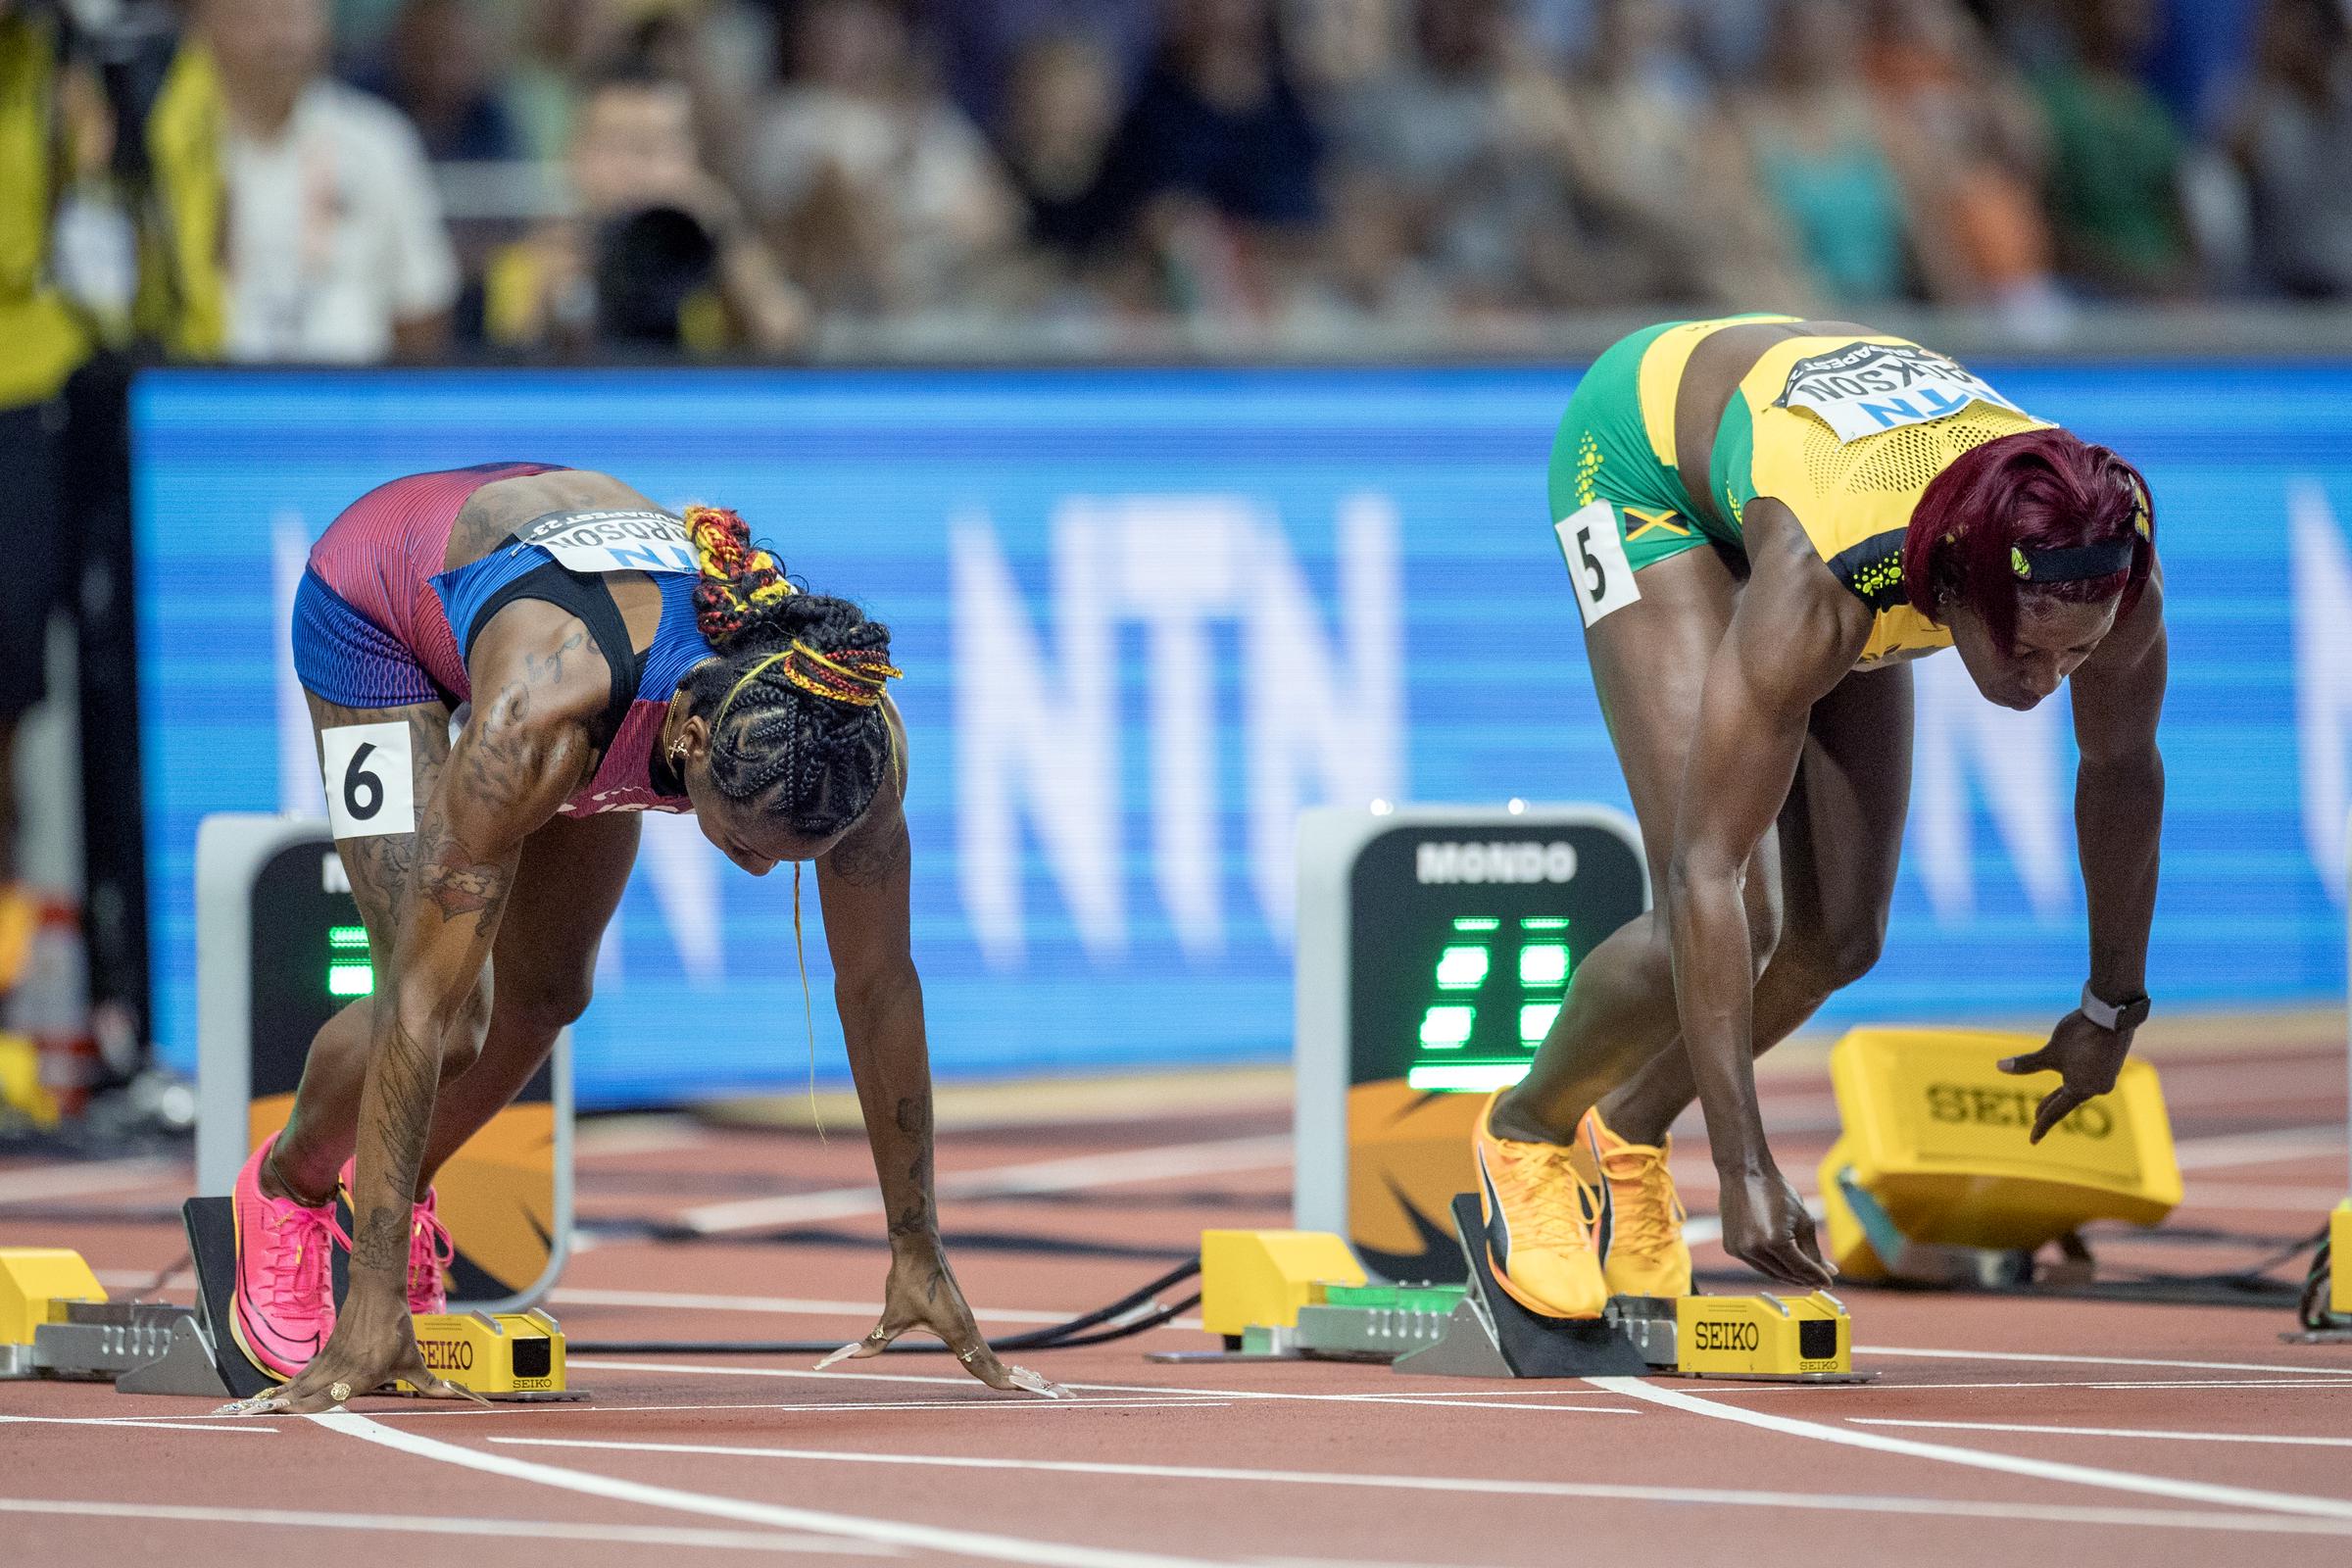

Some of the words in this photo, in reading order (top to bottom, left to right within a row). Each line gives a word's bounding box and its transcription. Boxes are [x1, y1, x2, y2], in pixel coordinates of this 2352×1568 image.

[533, 519, 560, 536] 23
[1577, 525, 1606, 605] 5
[949, 490, 1409, 968] NTN
[343, 742, 384, 821] 6
[1417, 841, 1577, 883] MONDO
[1694, 1321, 1760, 1351] SEIKO
[1799, 1360, 1838, 1371] SEIKO
[513, 1379, 553, 1389] SEIKO
